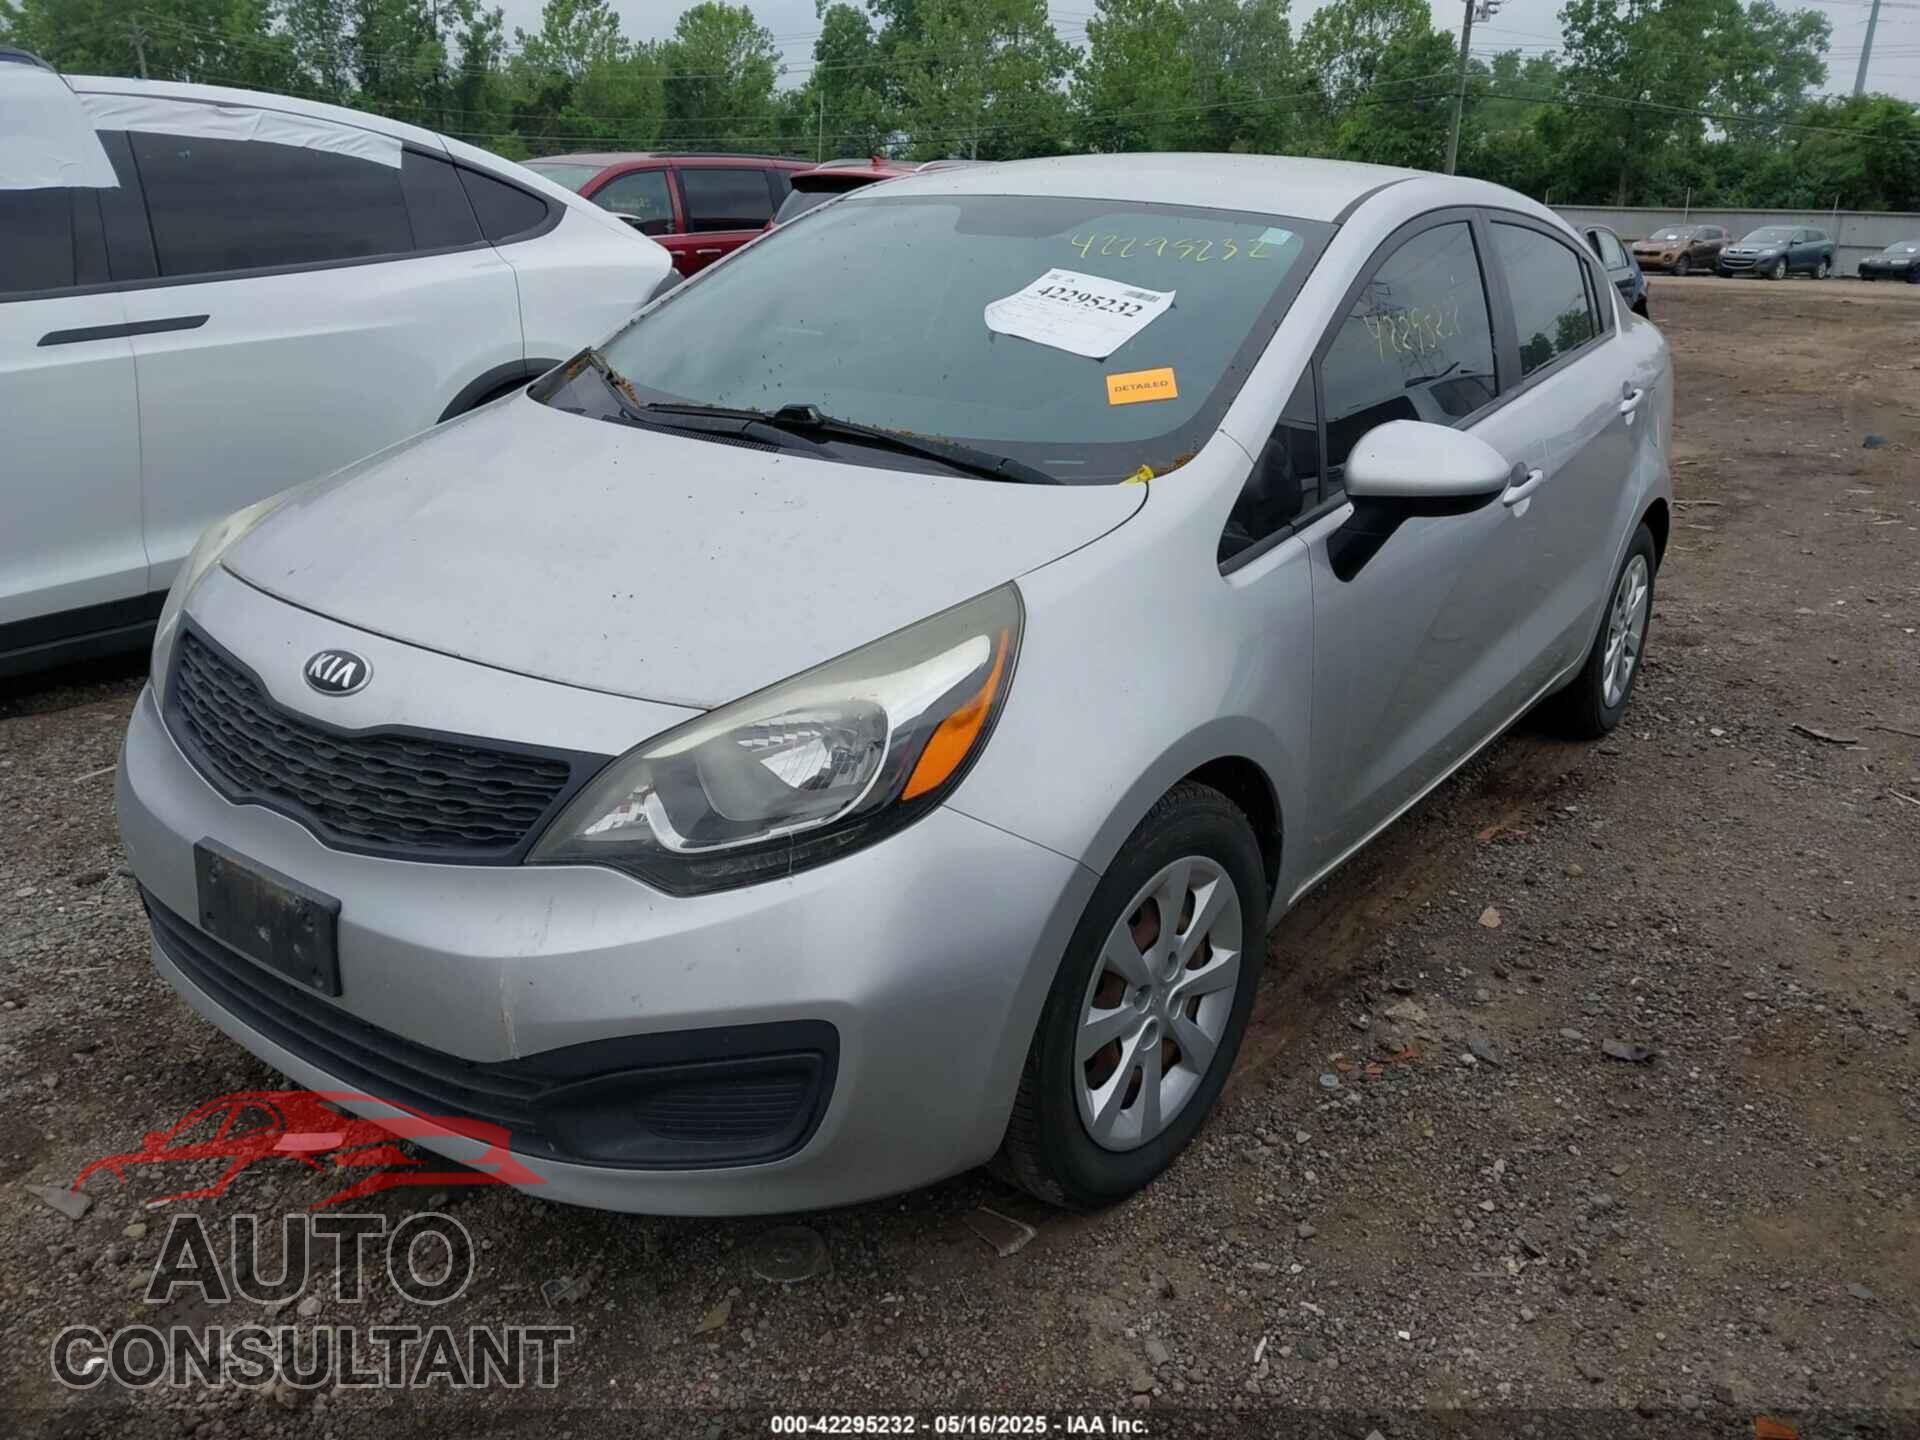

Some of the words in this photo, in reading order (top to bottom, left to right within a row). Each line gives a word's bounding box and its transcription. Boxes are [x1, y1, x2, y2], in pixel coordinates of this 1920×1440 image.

[1037, 285, 1143, 318] 42295232
[1114, 380, 1169, 394] DETAILED
[308, 653, 357, 688] KIA
